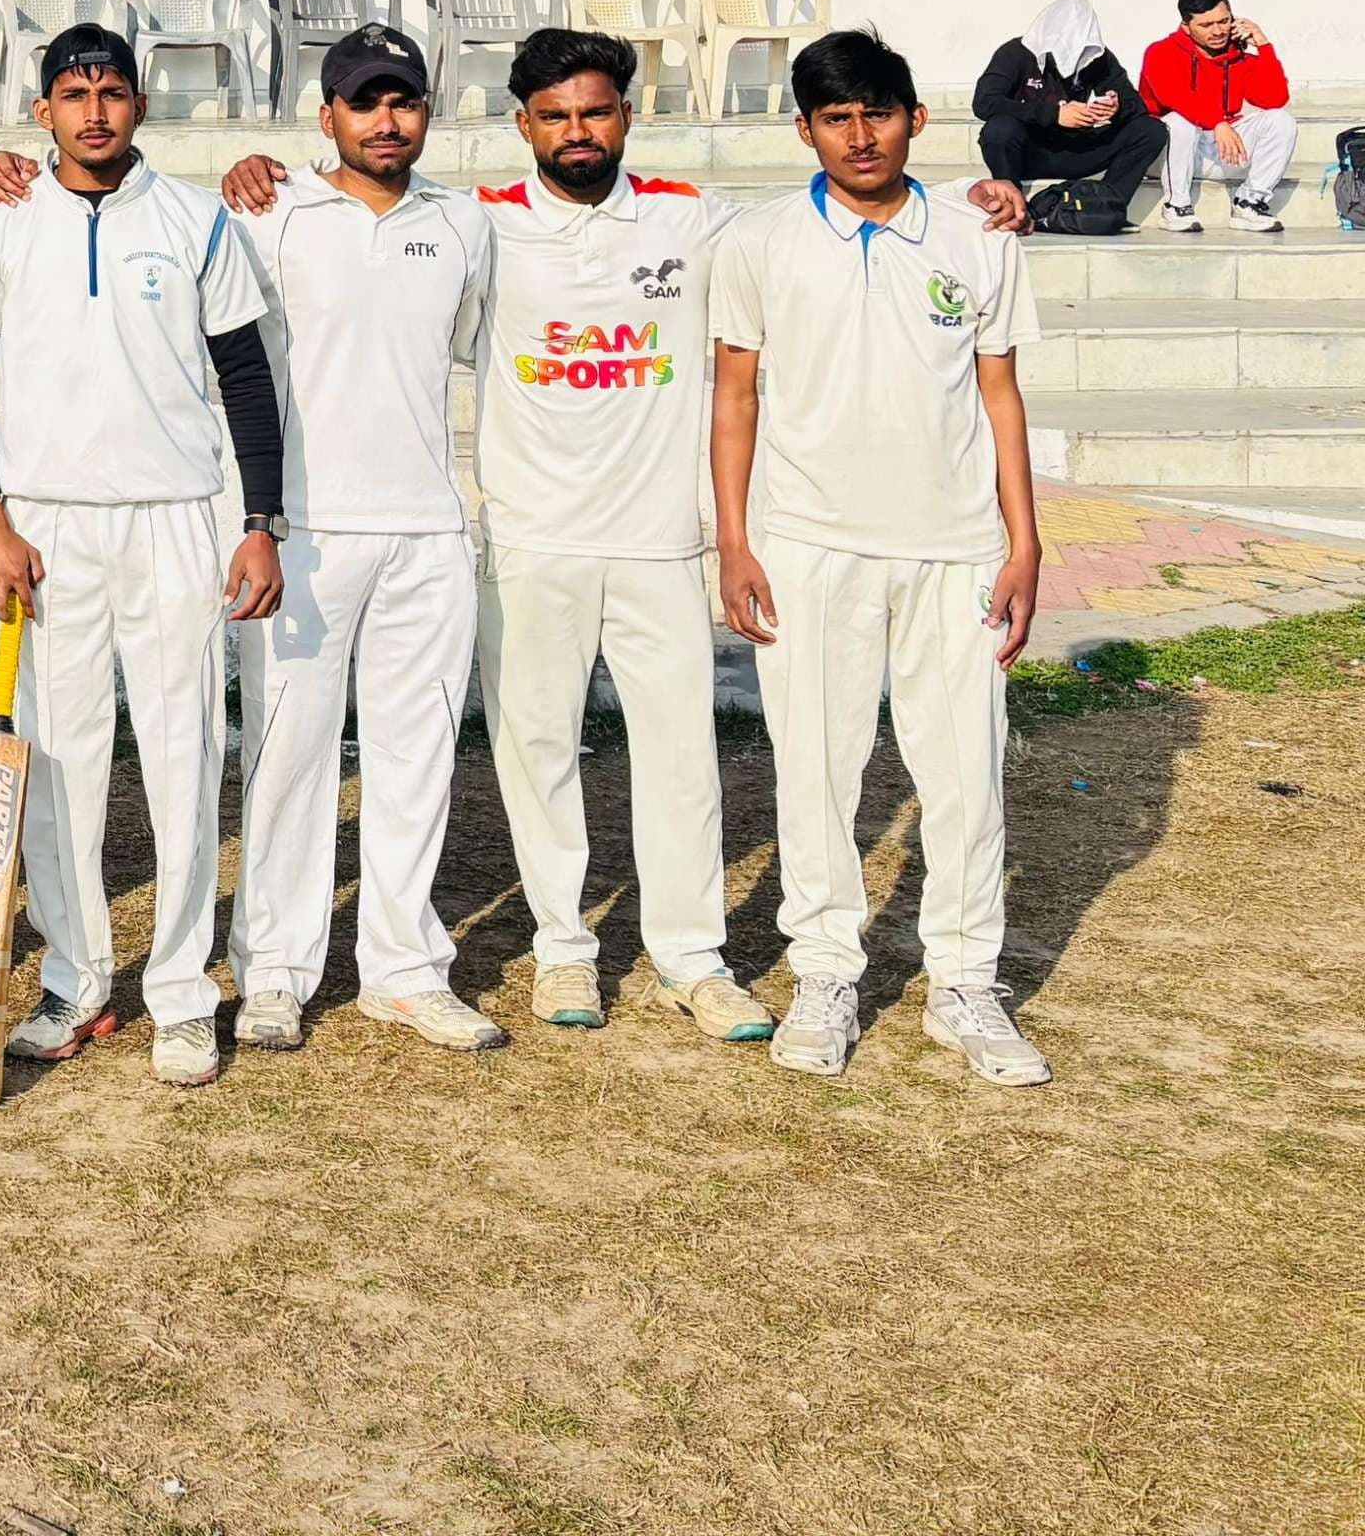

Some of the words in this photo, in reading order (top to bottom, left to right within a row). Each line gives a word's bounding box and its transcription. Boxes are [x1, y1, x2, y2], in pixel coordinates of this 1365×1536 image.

[405, 242, 437, 257] ATK
[644, 284, 681, 300] SAM
[929, 314, 962, 327] BCA
[543, 321, 658, 356] SAM
[514, 354, 674, 389] SPORTS
